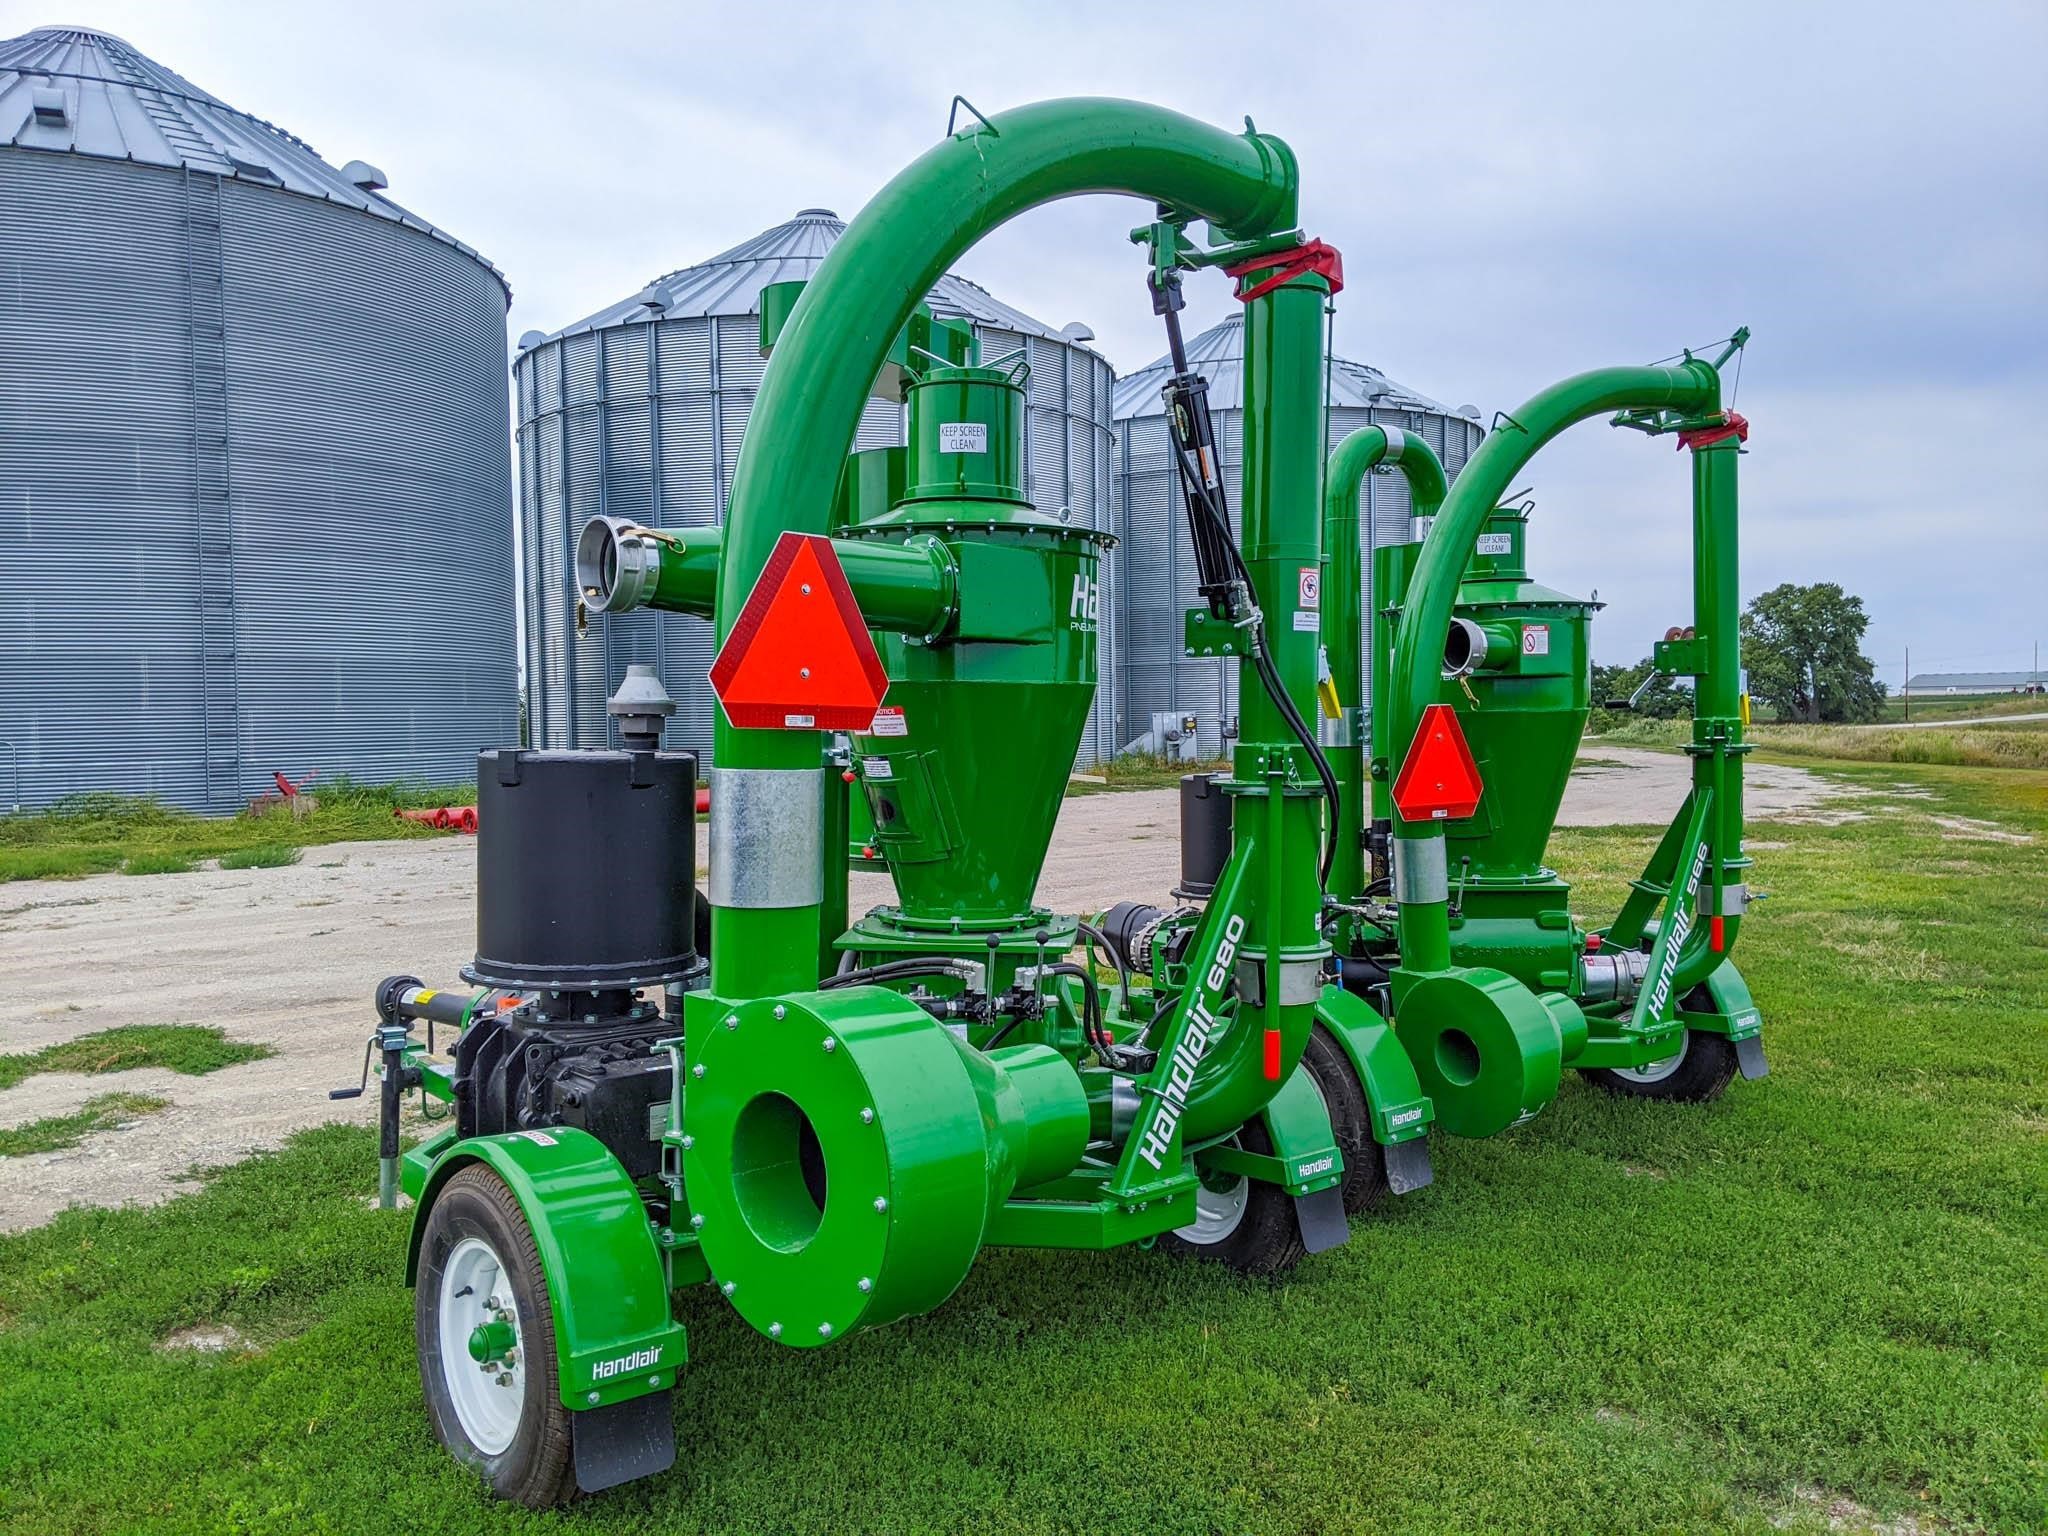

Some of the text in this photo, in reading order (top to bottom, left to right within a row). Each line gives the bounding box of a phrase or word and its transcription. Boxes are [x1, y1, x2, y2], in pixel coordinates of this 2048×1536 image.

[942, 426, 985, 437] KEEP SCREEN
[951, 439, 976, 450] CLEAN!
[1648, 842, 1708, 1021] Handlair 566
[1140, 914, 1245, 1170] Handlair 680
[1392, 1107, 1422, 1126] Handlair
[1299, 1156, 1333, 1177] Handlair
[592, 1345, 662, 1380] Handlair
